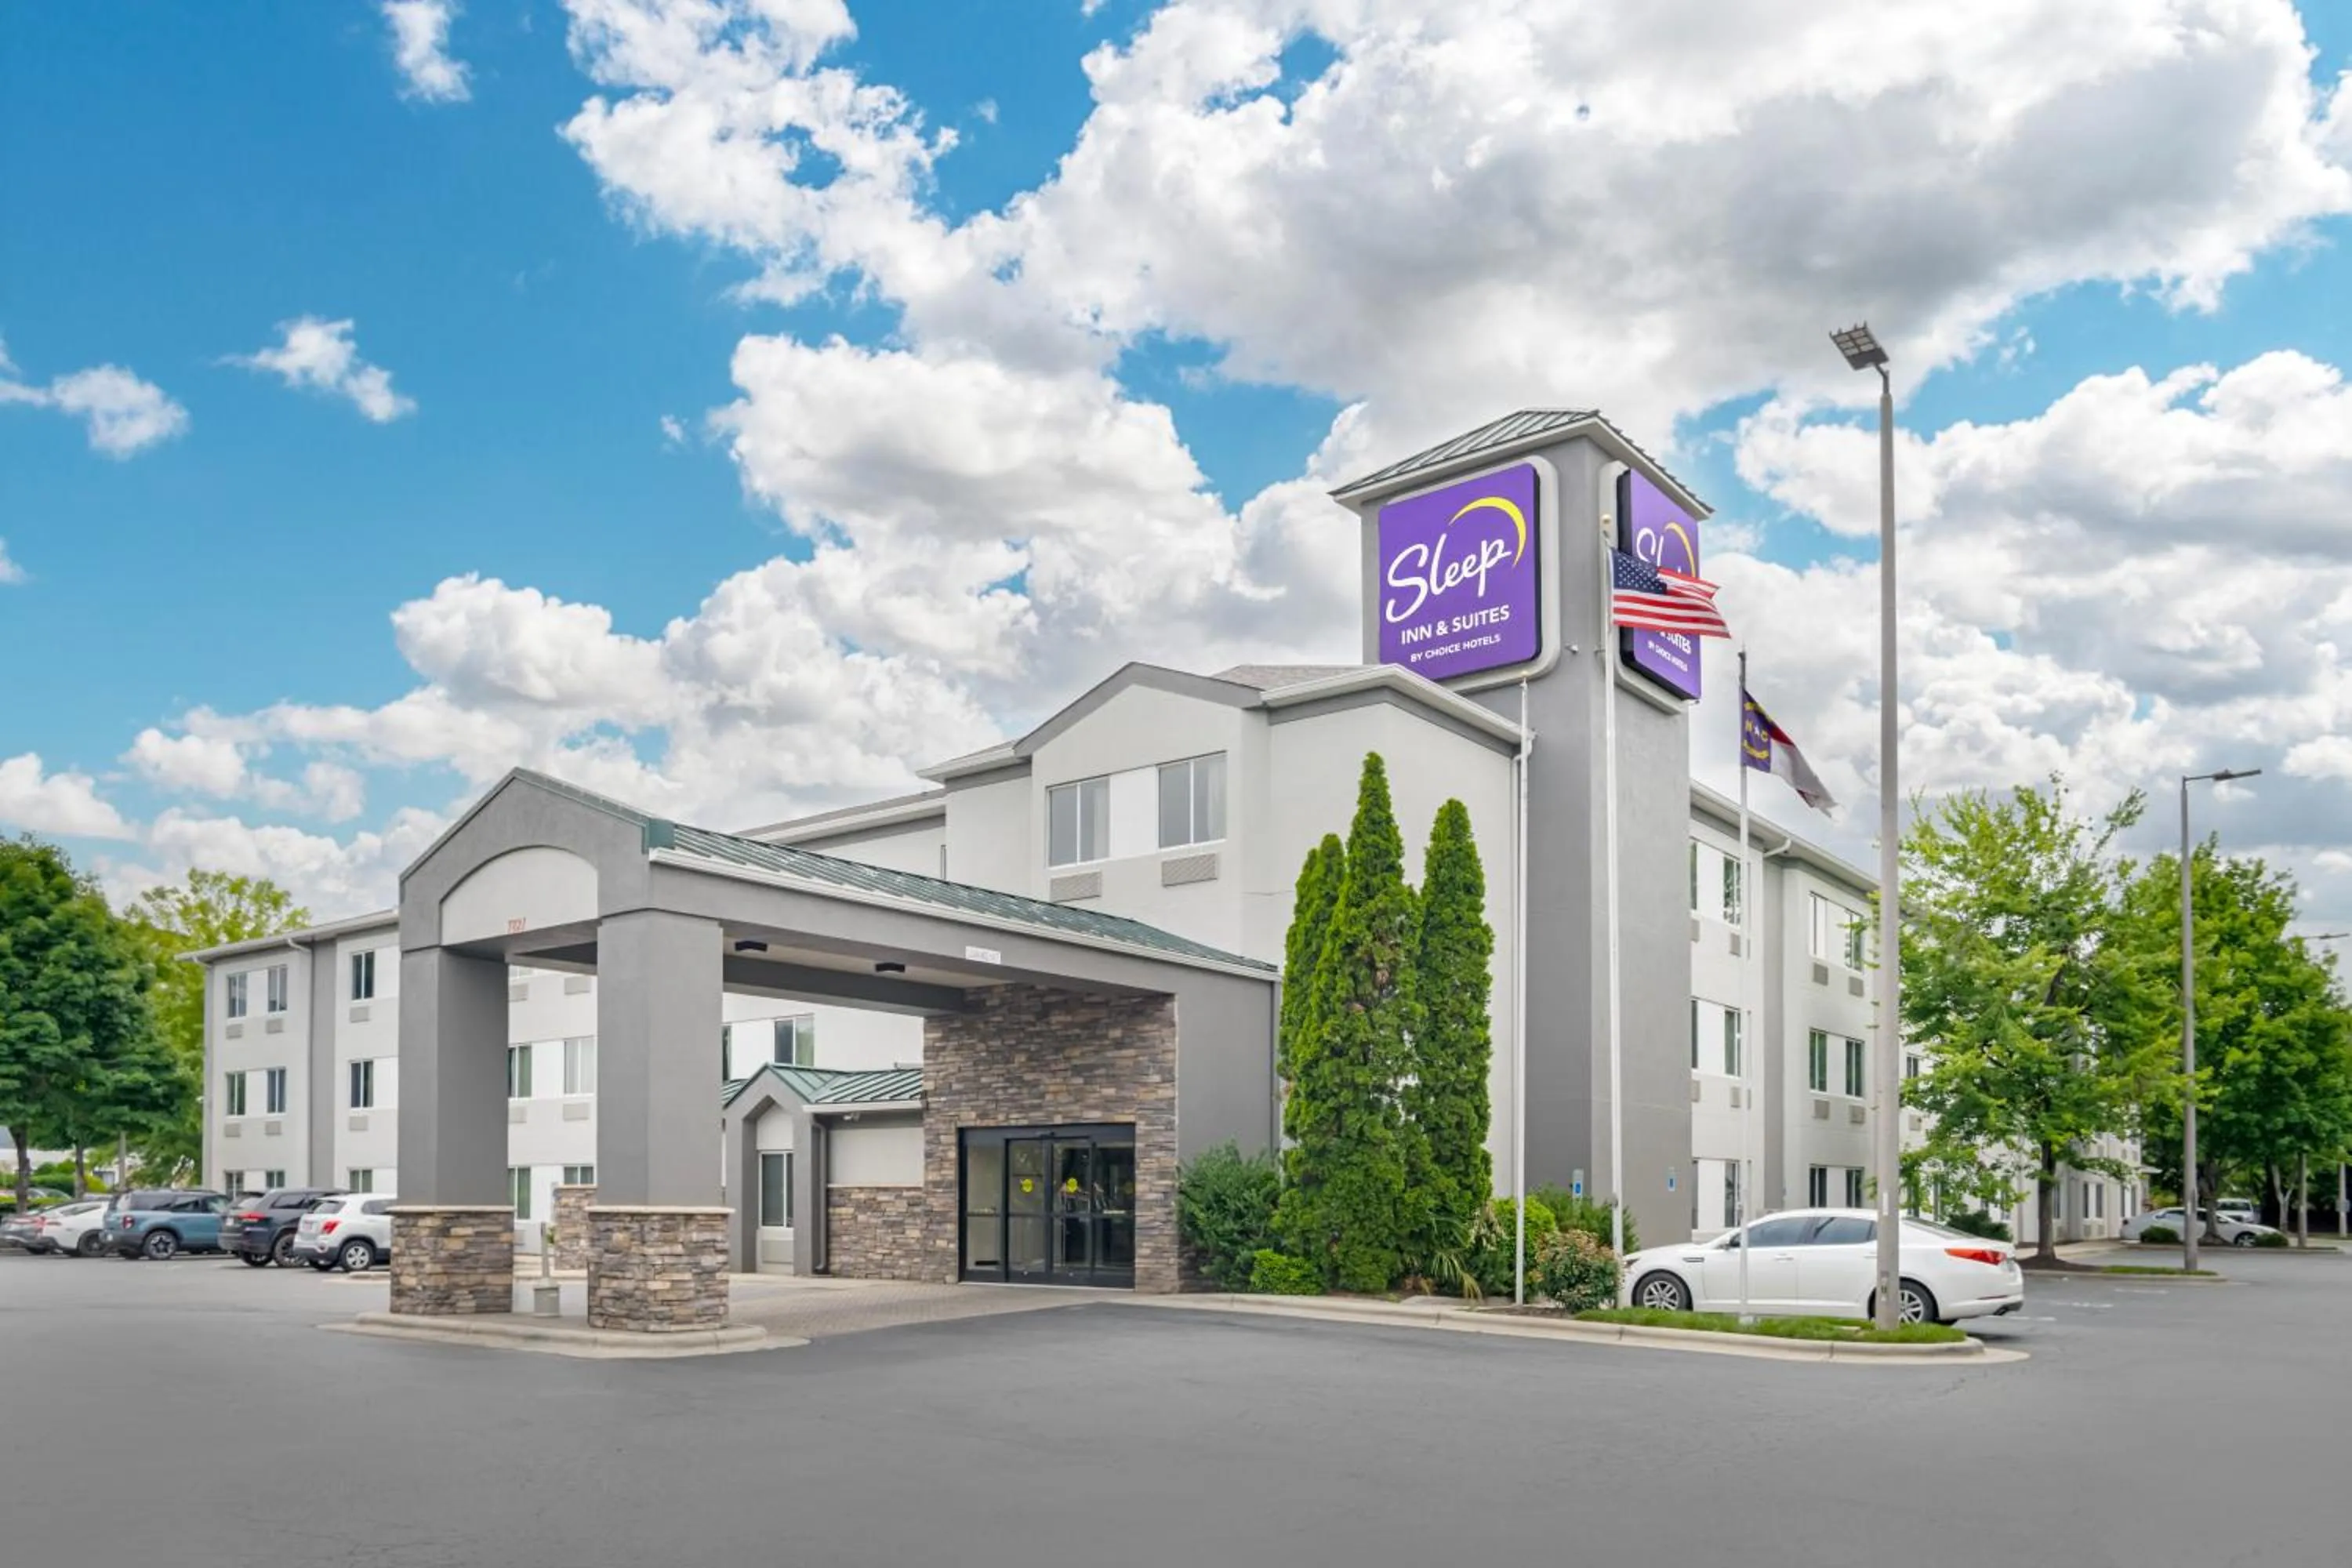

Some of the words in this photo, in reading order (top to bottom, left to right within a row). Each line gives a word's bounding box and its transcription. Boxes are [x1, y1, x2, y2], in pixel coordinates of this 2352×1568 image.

[1385, 532, 1512, 623] Sleep
[1401, 624, 1432, 644] INN
[1436, 620, 1449, 637] &
[1452, 604, 1510, 633] SUITES
[1410, 652, 1423, 662] BY
[1425, 641, 1461, 659] CHOICE
[1462, 633, 1501, 650] HOTELS
